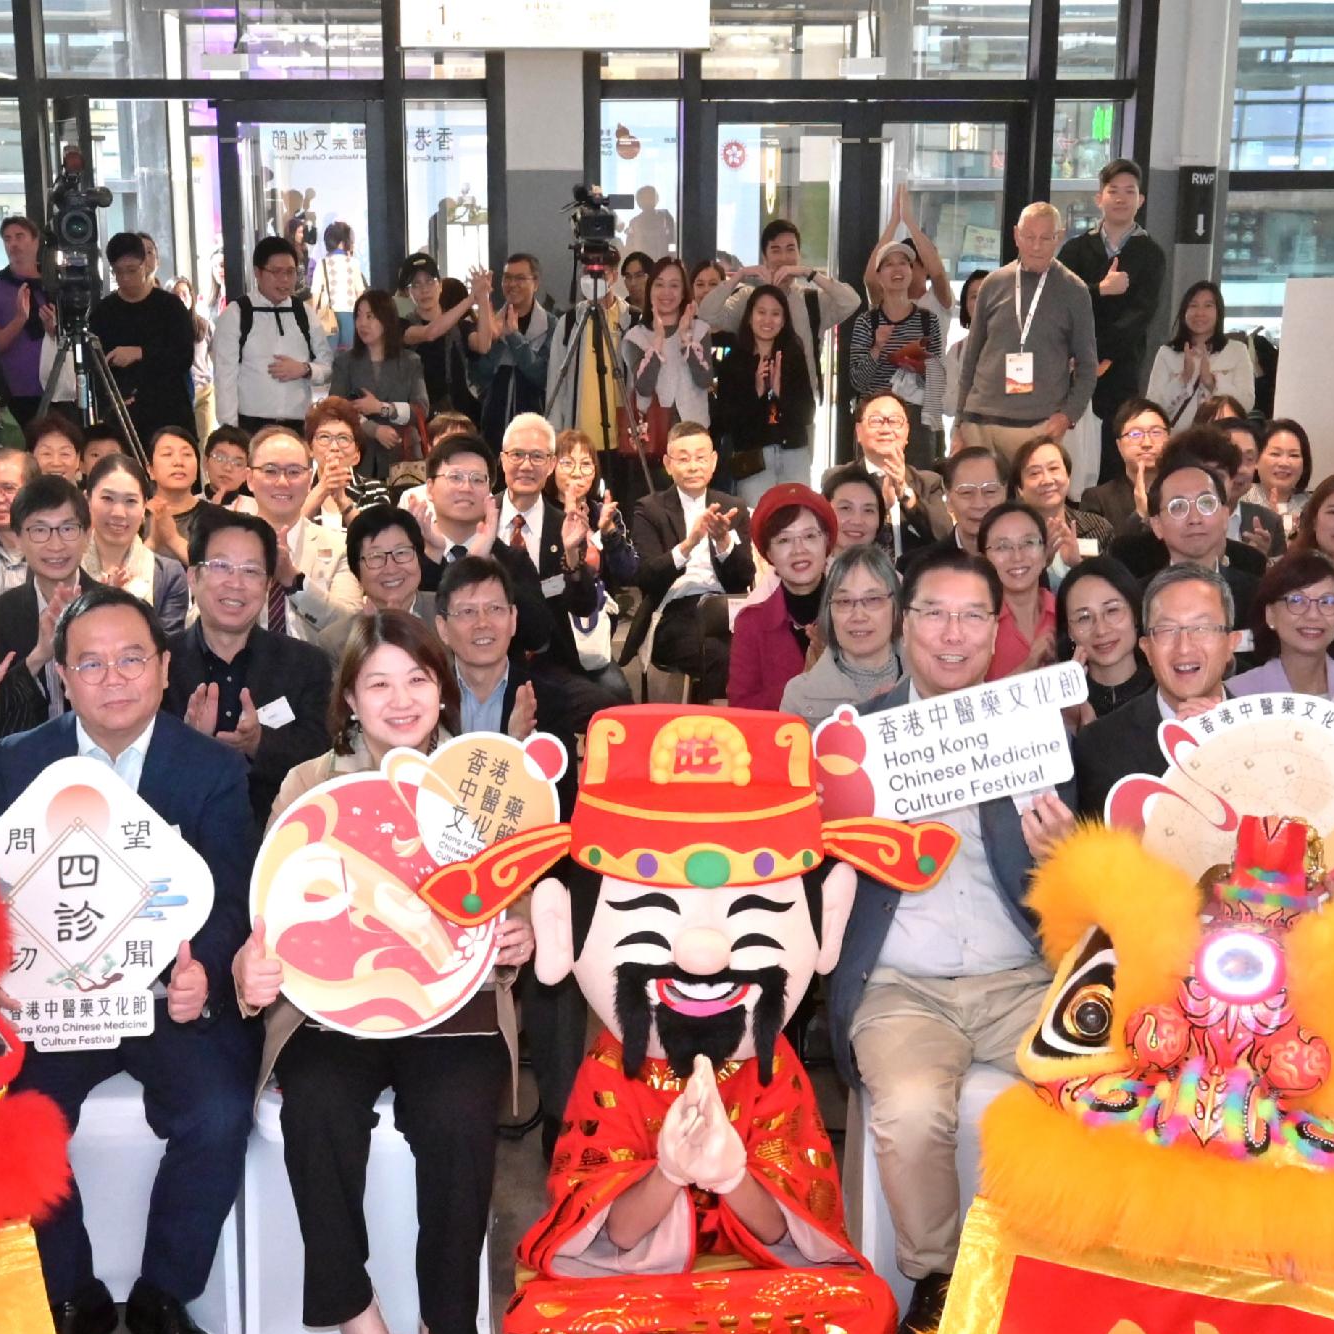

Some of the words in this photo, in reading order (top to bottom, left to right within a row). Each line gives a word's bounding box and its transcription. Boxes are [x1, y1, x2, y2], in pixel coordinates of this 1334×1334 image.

[1191, 172, 1215, 184] RWP
[877, 668, 1081, 745] 香港中醫藥文化節
[467, 747, 511, 786] 香港
[884, 745, 934, 769] Hong
[939, 732, 989, 754] Kong
[889, 761, 966, 792] Chinese
[970, 739, 1061, 772] Medicine
[457, 777, 526, 826] 中醫藥
[894, 787, 965, 815] Culture
[970, 765, 1045, 797] Festival
[5, 827, 36, 855] 問
[120, 820, 152, 850] 望
[54, 854, 105, 942] 四診
[120, 940, 154, 968] 聞
[35, 1024, 60, 1035] Kong
[62, 1020, 102, 1033] Chinese
[104, 1018, 148, 1031] Medicine
[41, 1034, 76, 1047] Culture
[79, 1035, 115, 1045] Festival
